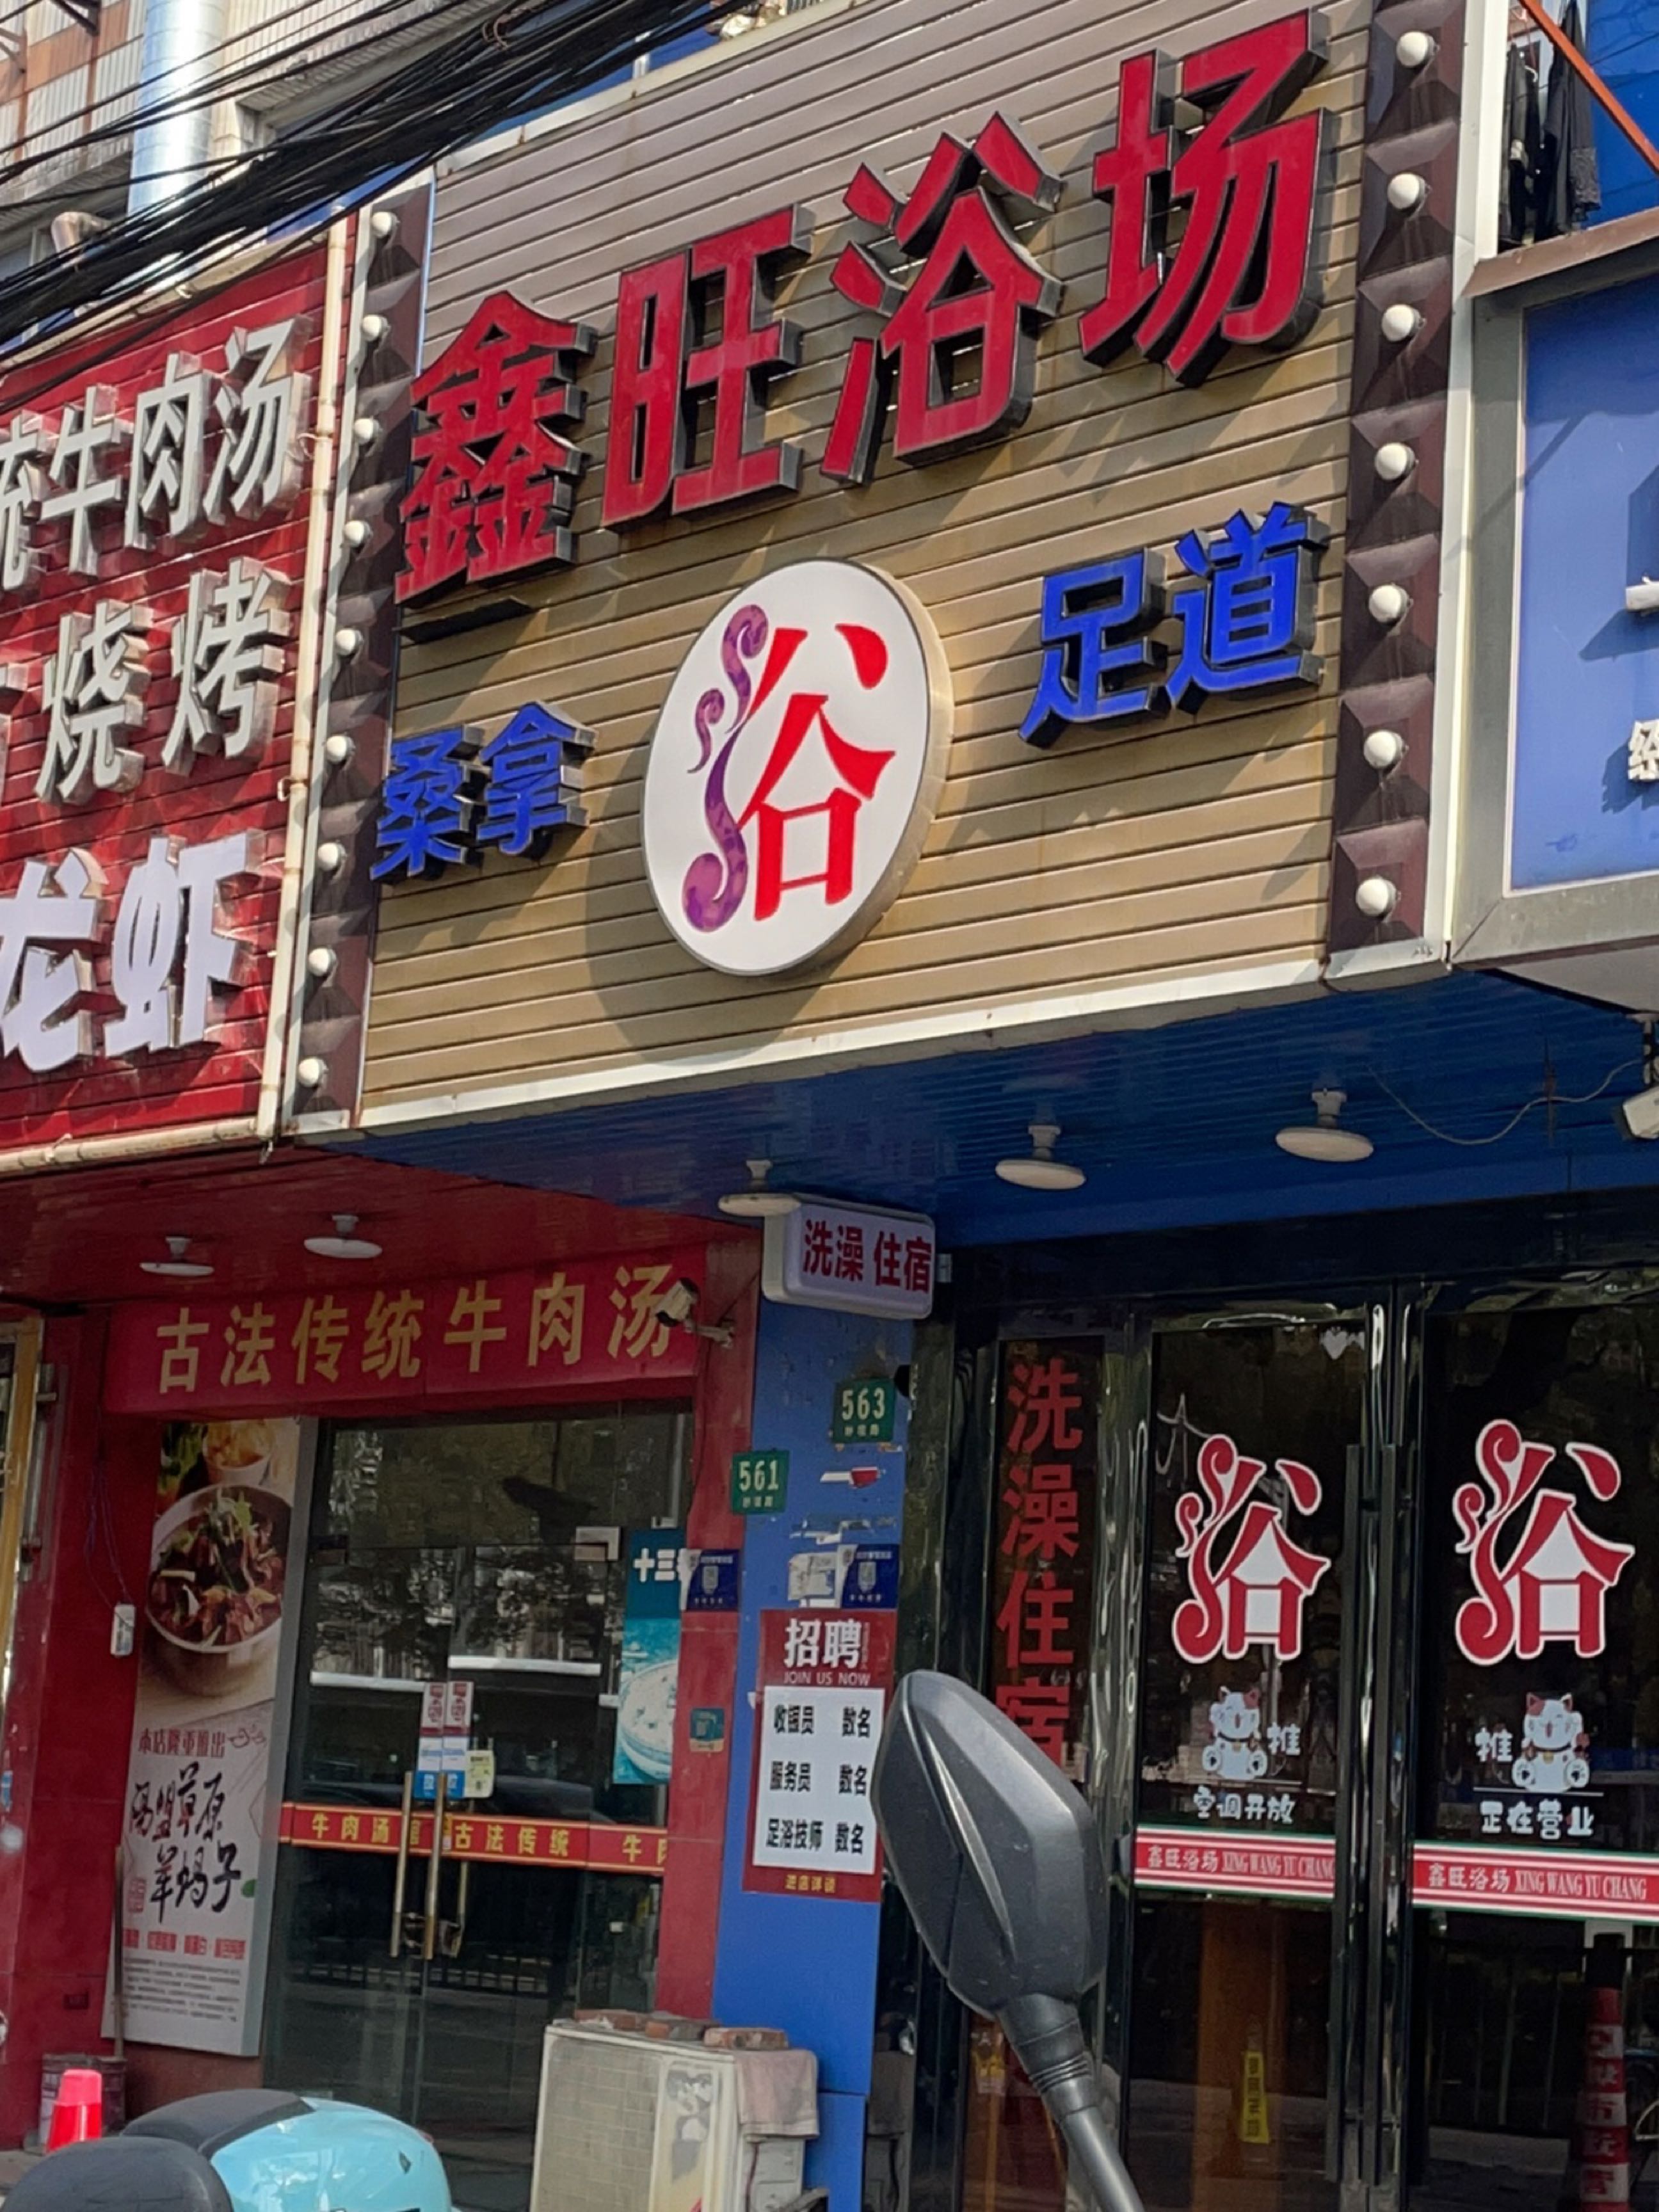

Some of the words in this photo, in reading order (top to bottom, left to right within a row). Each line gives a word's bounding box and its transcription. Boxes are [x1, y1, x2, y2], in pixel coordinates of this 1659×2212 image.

[392, 8, 1328, 605] 鑫旺浴场
[1018, 501, 1310, 742] 足道
[0, 557, 270, 800] 烧烤
[680, 602, 899, 934] 浴
[369, 700, 581, 883] 桑拿
[0, 832, 250, 1073] 龙虾
[156, 1263, 674, 1394] 古法传统牛肉汤
[842, 1387, 886, 1420] 563
[739, 1459, 780, 1492] 561
[632, 1547, 683, 1583] 十三
[783, 1618, 862, 1669] 招聘
[783, 1671, 812, 1684] JOIN
[816, 1671, 833, 1685] US
[838, 1672, 870, 1686] NOW
[1267, 1722, 1302, 1758] 推
[1475, 1727, 1515, 1764] 推
[770, 1761, 812, 1792] 服务员
[1192, 1784, 1295, 1824] 空调开放
[1479, 1799, 1595, 1841] 正在营业
[454, 1822, 570, 1857] 古法传统
[1148, 1845, 1219, 1873] 鑫旺浴场
[1223, 1852, 1249, 1873] XING
[1250, 1853, 1282, 1875] WANG
[1283, 1855, 1298, 1877] YU
[1429, 1862, 1511, 1893] 鑫旺浴场
[1514, 1870, 1545, 1894] XING
[1546, 1871, 1583, 1896] WANG
[1584, 1874, 1603, 1898] YU
[1603, 1875, 1647, 1901] CHANG
